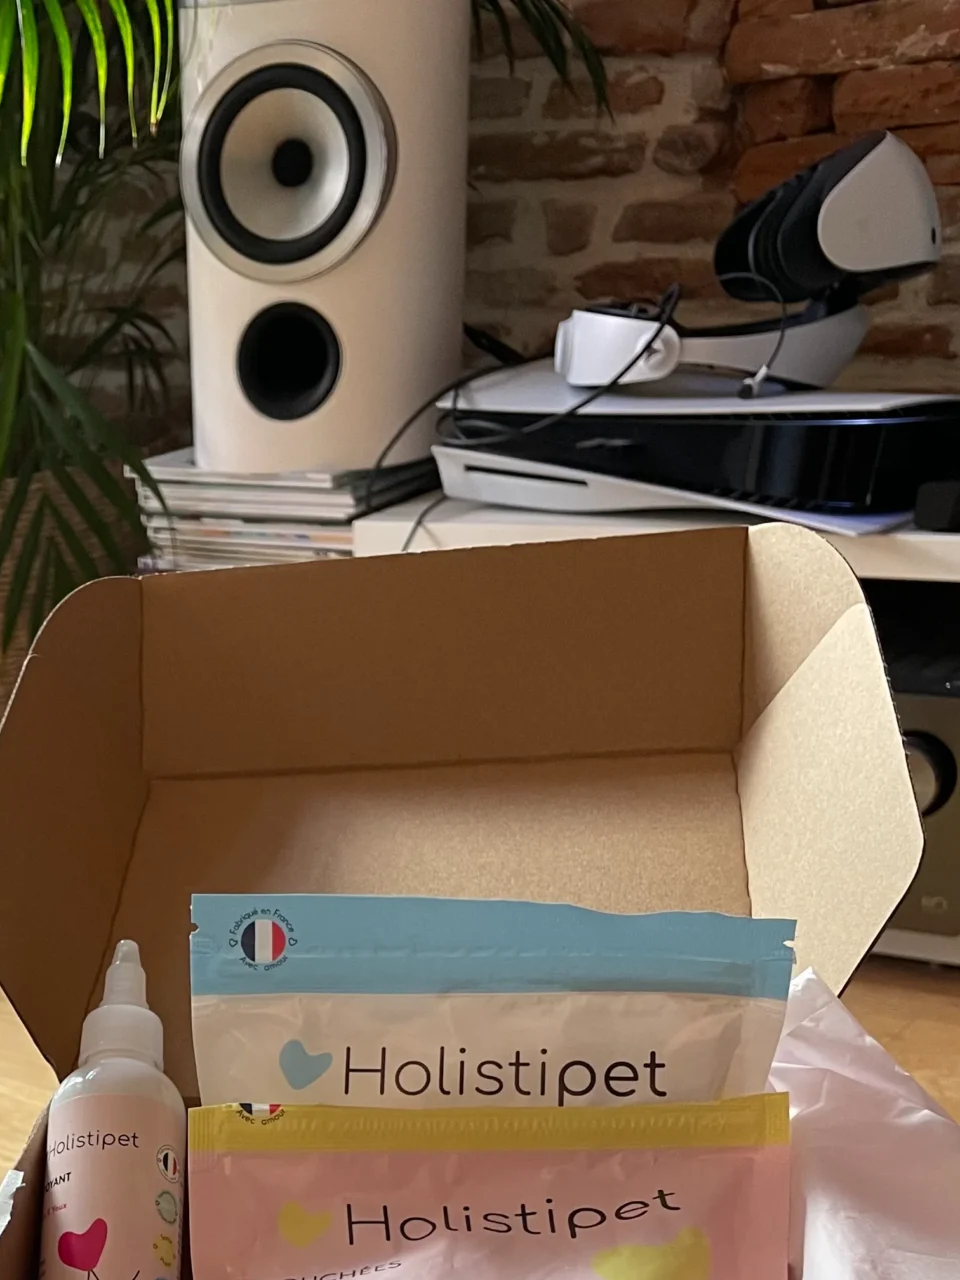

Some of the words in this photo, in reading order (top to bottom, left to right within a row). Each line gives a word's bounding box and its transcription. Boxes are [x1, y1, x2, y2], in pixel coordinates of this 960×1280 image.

[260, 908, 271, 916] en
[272, 908, 295, 932] France
[239, 956, 259, 971] Avec
[344, 1046, 667, 1107] Holistipet
[235, 1109, 256, 1125] Avec
[260, 1108, 287, 1126] amour
[47, 1129, 140, 1160] Holistipet
[346, 1189, 681, 1245] Holistipet
